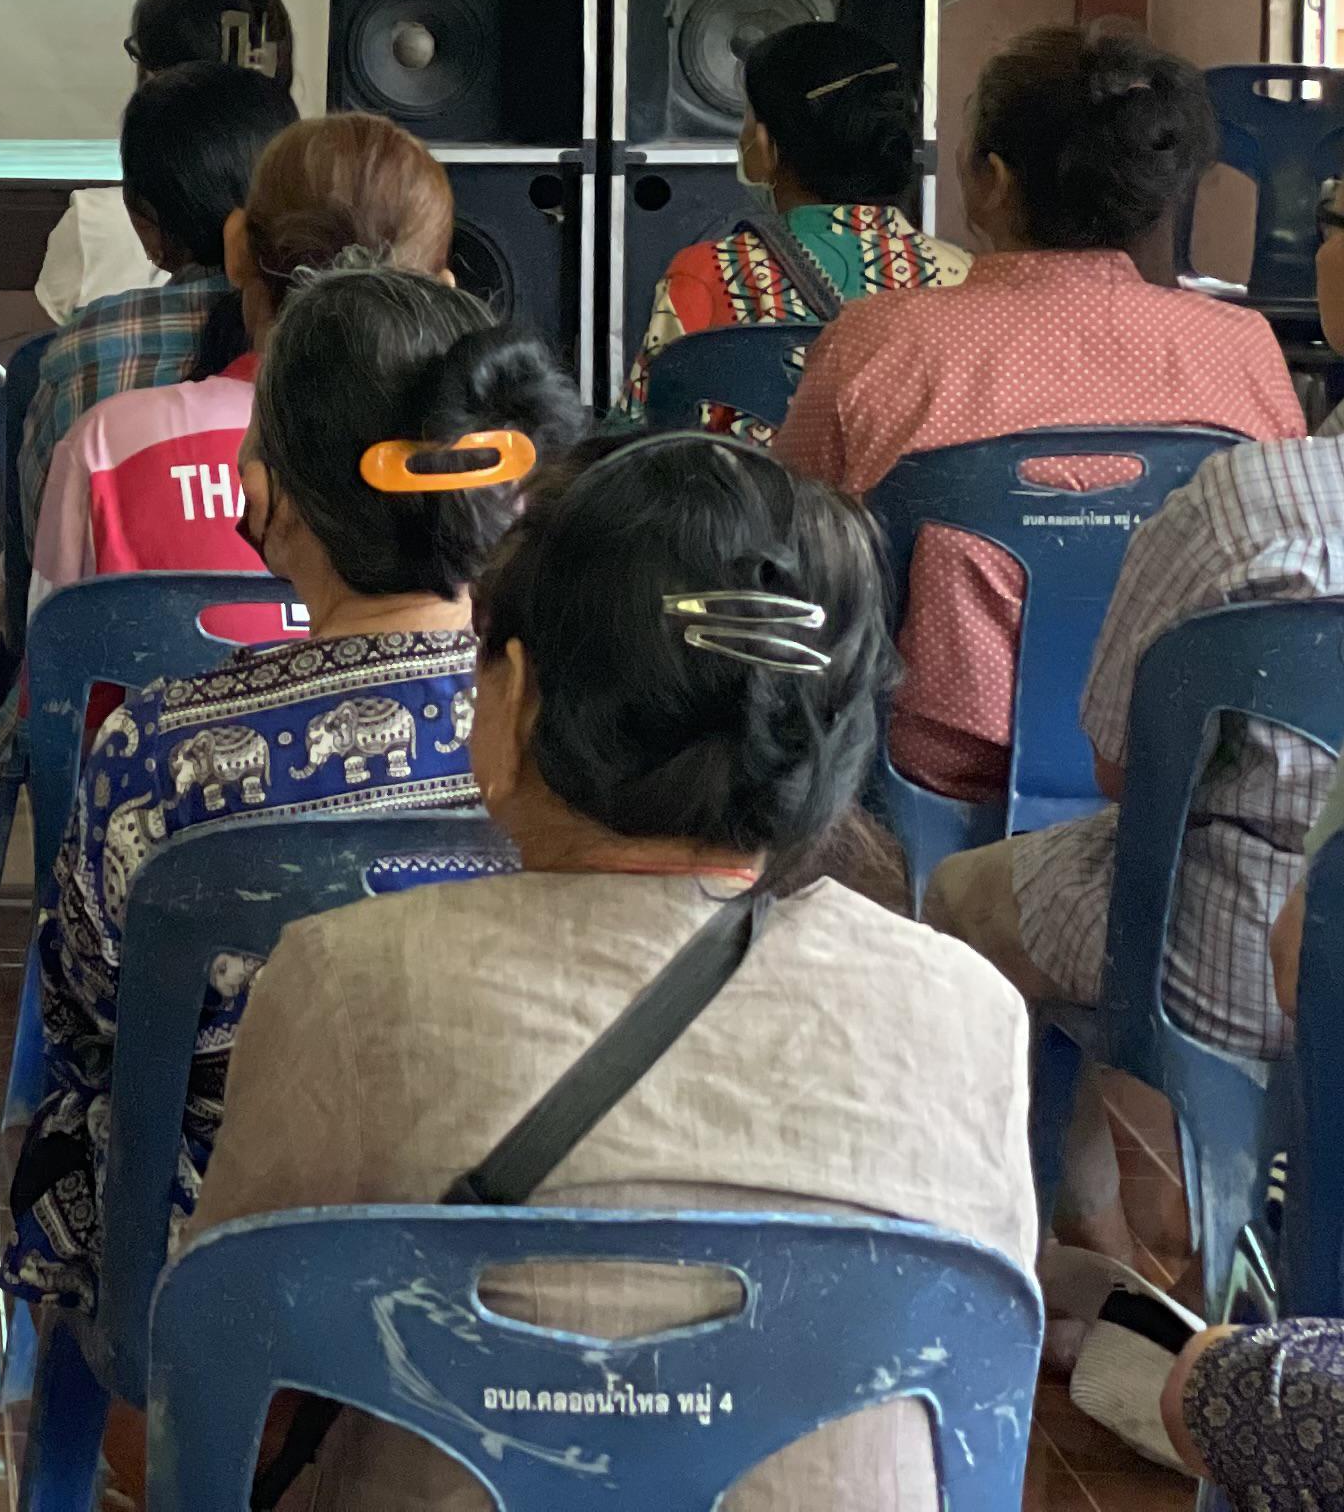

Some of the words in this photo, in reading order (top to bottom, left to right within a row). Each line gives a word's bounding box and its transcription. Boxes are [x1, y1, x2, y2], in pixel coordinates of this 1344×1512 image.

[483, 1373, 670, 1415] อบต.คลองน้ำไหล
[677, 1382, 711, 1425] หมู่
[719, 1392, 733, 1413] 4
